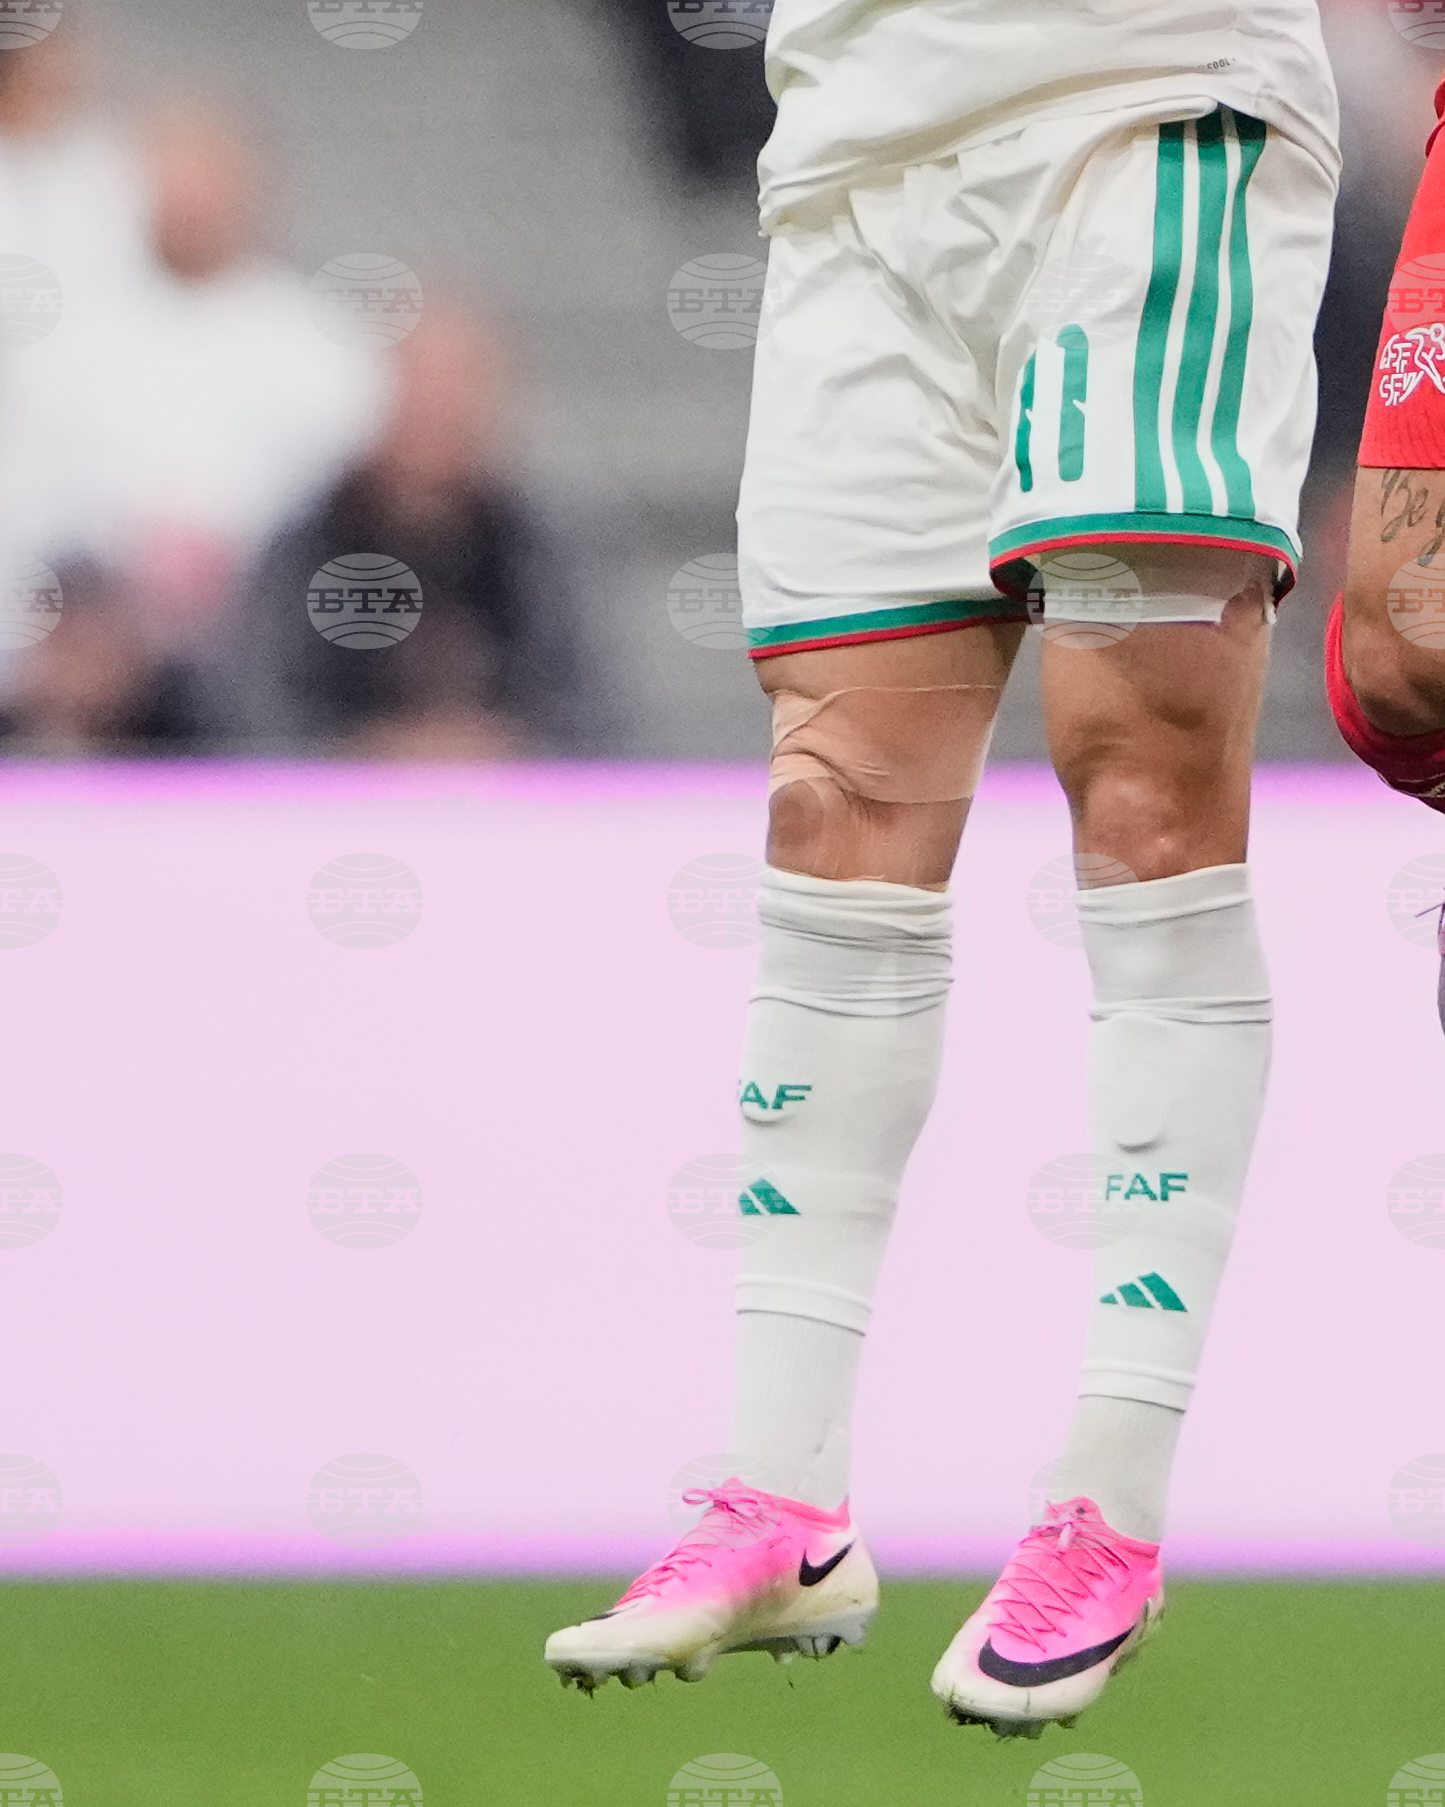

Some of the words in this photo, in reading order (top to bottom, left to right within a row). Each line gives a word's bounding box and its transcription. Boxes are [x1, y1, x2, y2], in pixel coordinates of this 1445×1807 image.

[1198, 57, 1231, 70] COOL
[738, 1080, 812, 1110] AF
[1105, 1172, 1188, 1201] FAF
